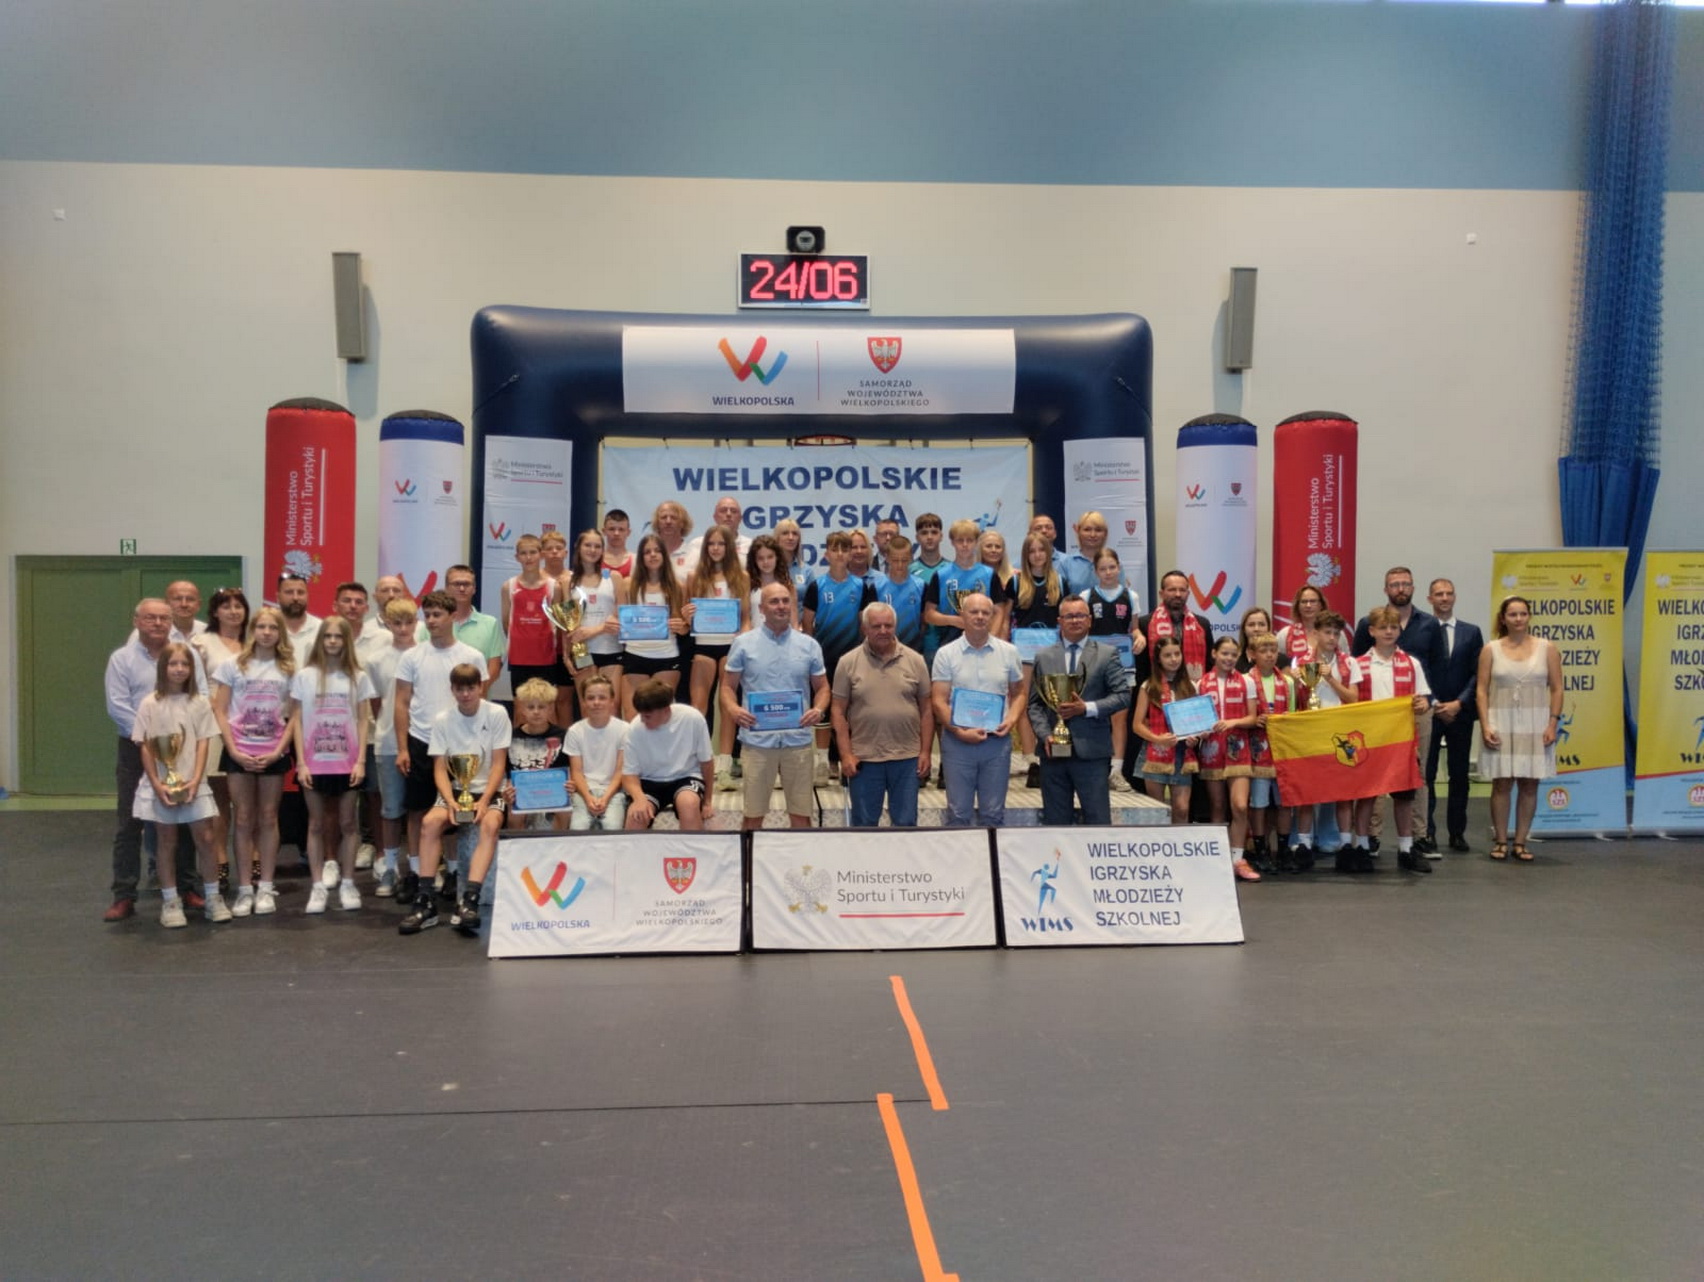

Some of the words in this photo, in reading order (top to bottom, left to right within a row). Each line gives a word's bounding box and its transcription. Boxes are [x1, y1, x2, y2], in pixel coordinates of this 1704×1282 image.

[750, 260, 858, 300] 24/06
[859, 380, 912, 388] SAMORZĄD
[712, 396, 795, 406] WIELKOPOLSKA
[847, 389, 923, 398] WOJEWÓDZTWA
[840, 398, 930, 407] WIELKOPOLSKIEGO
[302, 447, 315, 498] Turystyki
[673, 466, 962, 491] WIELKOPOLSKIE
[1322, 454, 1334, 504] Turystyki
[286, 470, 298, 546] Ministerstwo
[1308, 477, 1320, 549] Ministerstwo
[743, 504, 909, 530] GRZYSKA
[301, 508, 313, 546] Sportu
[1322, 513, 1334, 549] Sportu
[823, 592, 834, 604] 13
[1087, 841, 1220, 858] WIELKOPOLSKIE
[837, 870, 932, 884] Ministerstwo
[1090, 865, 1172, 881] IGRZYSKA
[837, 888, 886, 904] Sportu
[890, 889, 895, 901] i
[899, 887, 965, 904] Turystyki
[1093, 884, 1183, 904] MŁODZIEŻY
[655, 900, 706, 908] SAMORZĄD
[643, 908, 717, 917] WOJEWÓDZTWA
[1096, 911, 1181, 927] SZKOLNEJ
[511, 919, 590, 931] WIELKOPOLSKA
[635, 918, 723, 927] WIELKOPOLSKIEGO
[1020, 917, 1074, 932] WIMS
